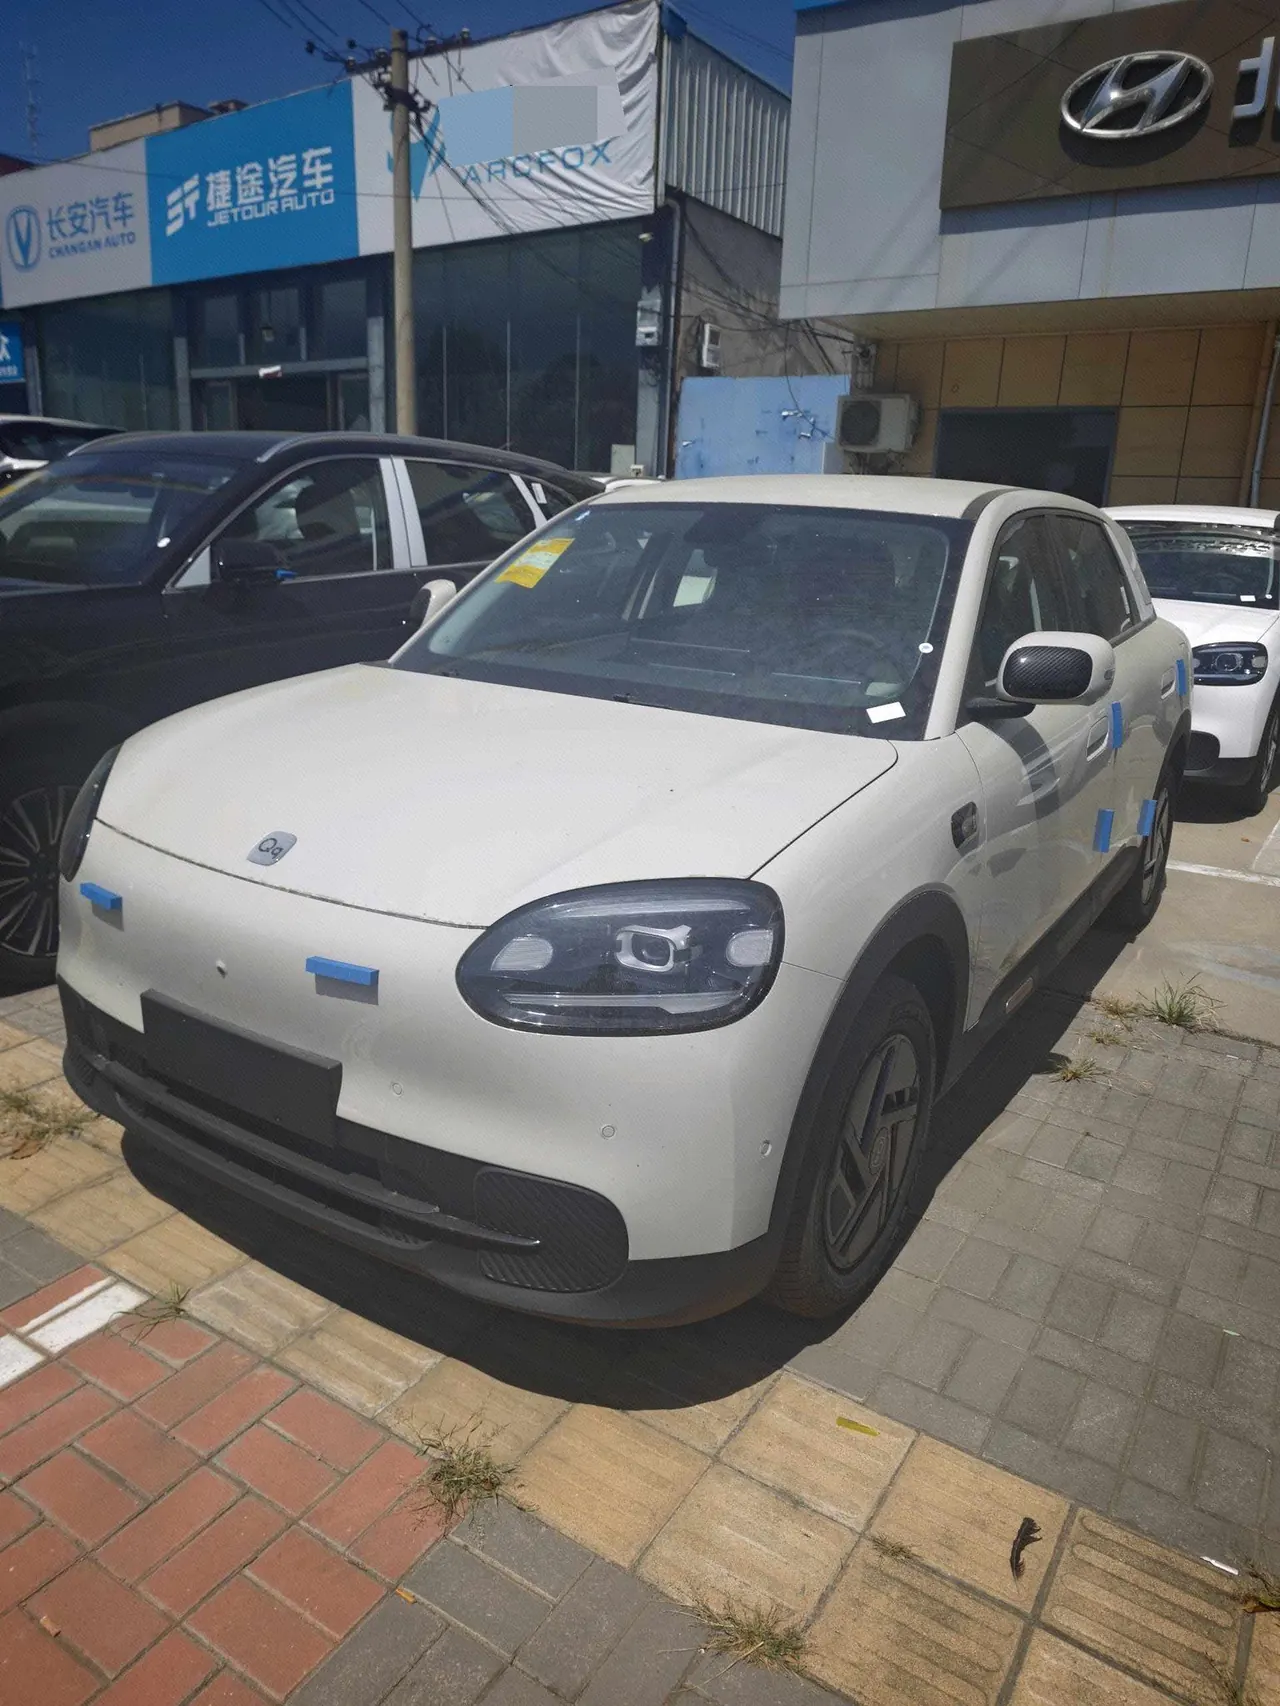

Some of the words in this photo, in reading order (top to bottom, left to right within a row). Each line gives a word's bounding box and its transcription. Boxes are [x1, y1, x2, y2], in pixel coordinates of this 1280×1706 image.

[205, 145, 334, 212] 捷途汽车
[462, 141, 612, 185] ARCFOX
[47, 191, 135, 241] 长安汽车
[207, 200, 279, 227] JETOUR
[281, 188, 335, 213] AUTO
[48, 239, 103, 258] CHANGAN
[104, 231, 136, 248] AUTO
